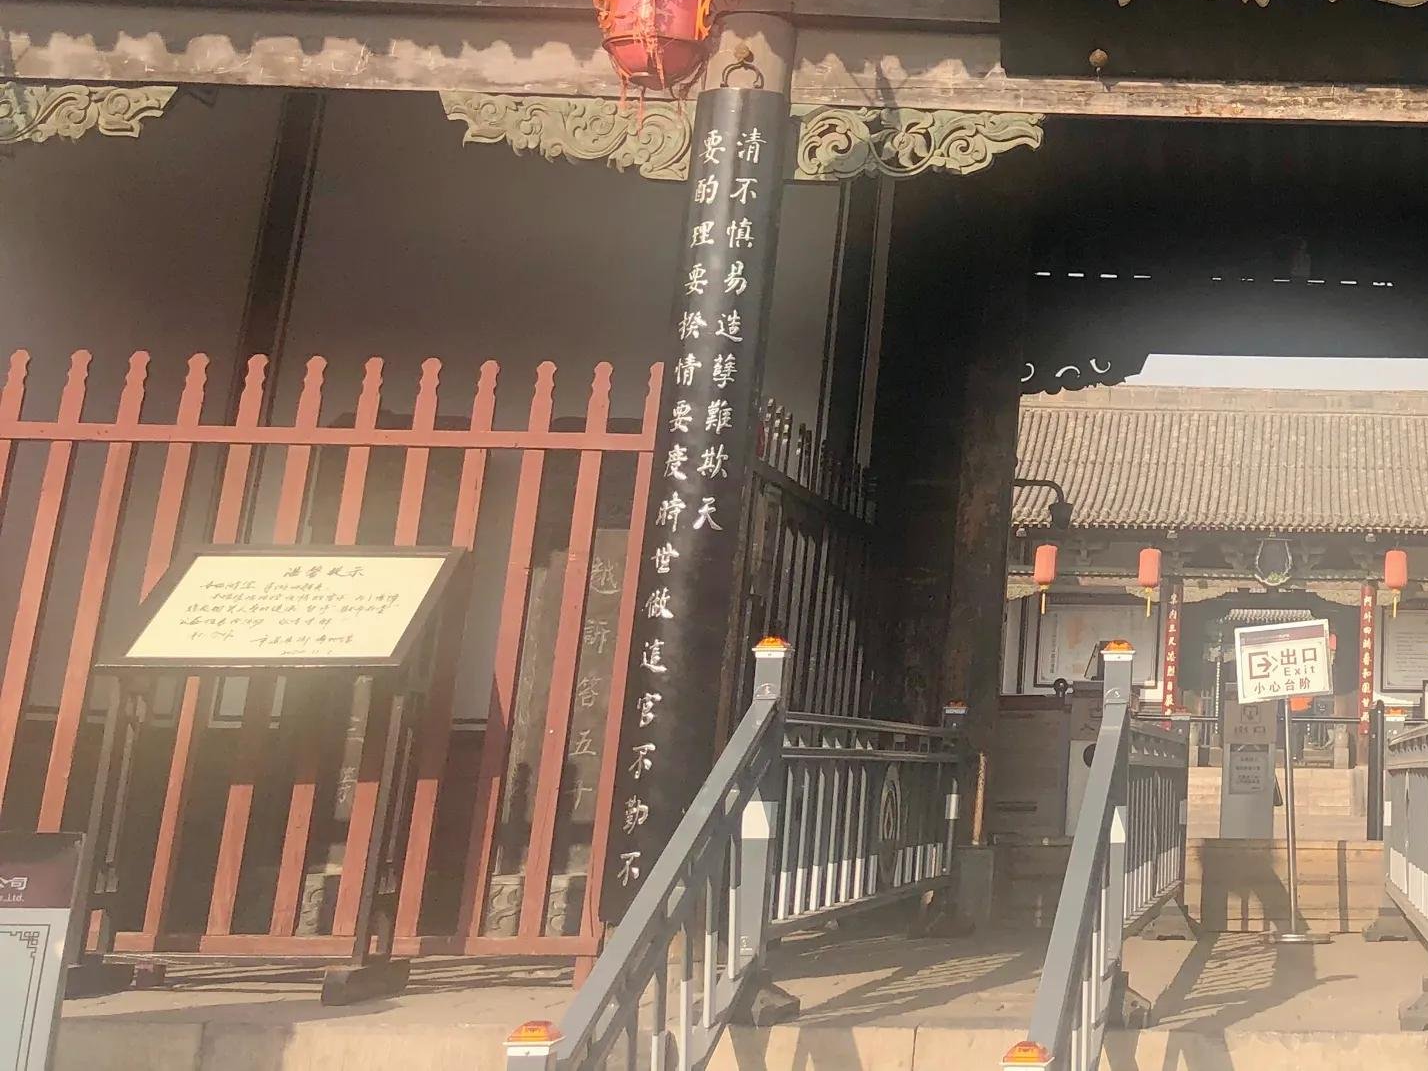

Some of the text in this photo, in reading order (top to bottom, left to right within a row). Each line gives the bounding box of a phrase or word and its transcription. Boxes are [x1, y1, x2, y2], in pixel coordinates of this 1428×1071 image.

[1280, 648, 1318, 666] 出口
[1254, 676, 1311, 694] 小心台阶
